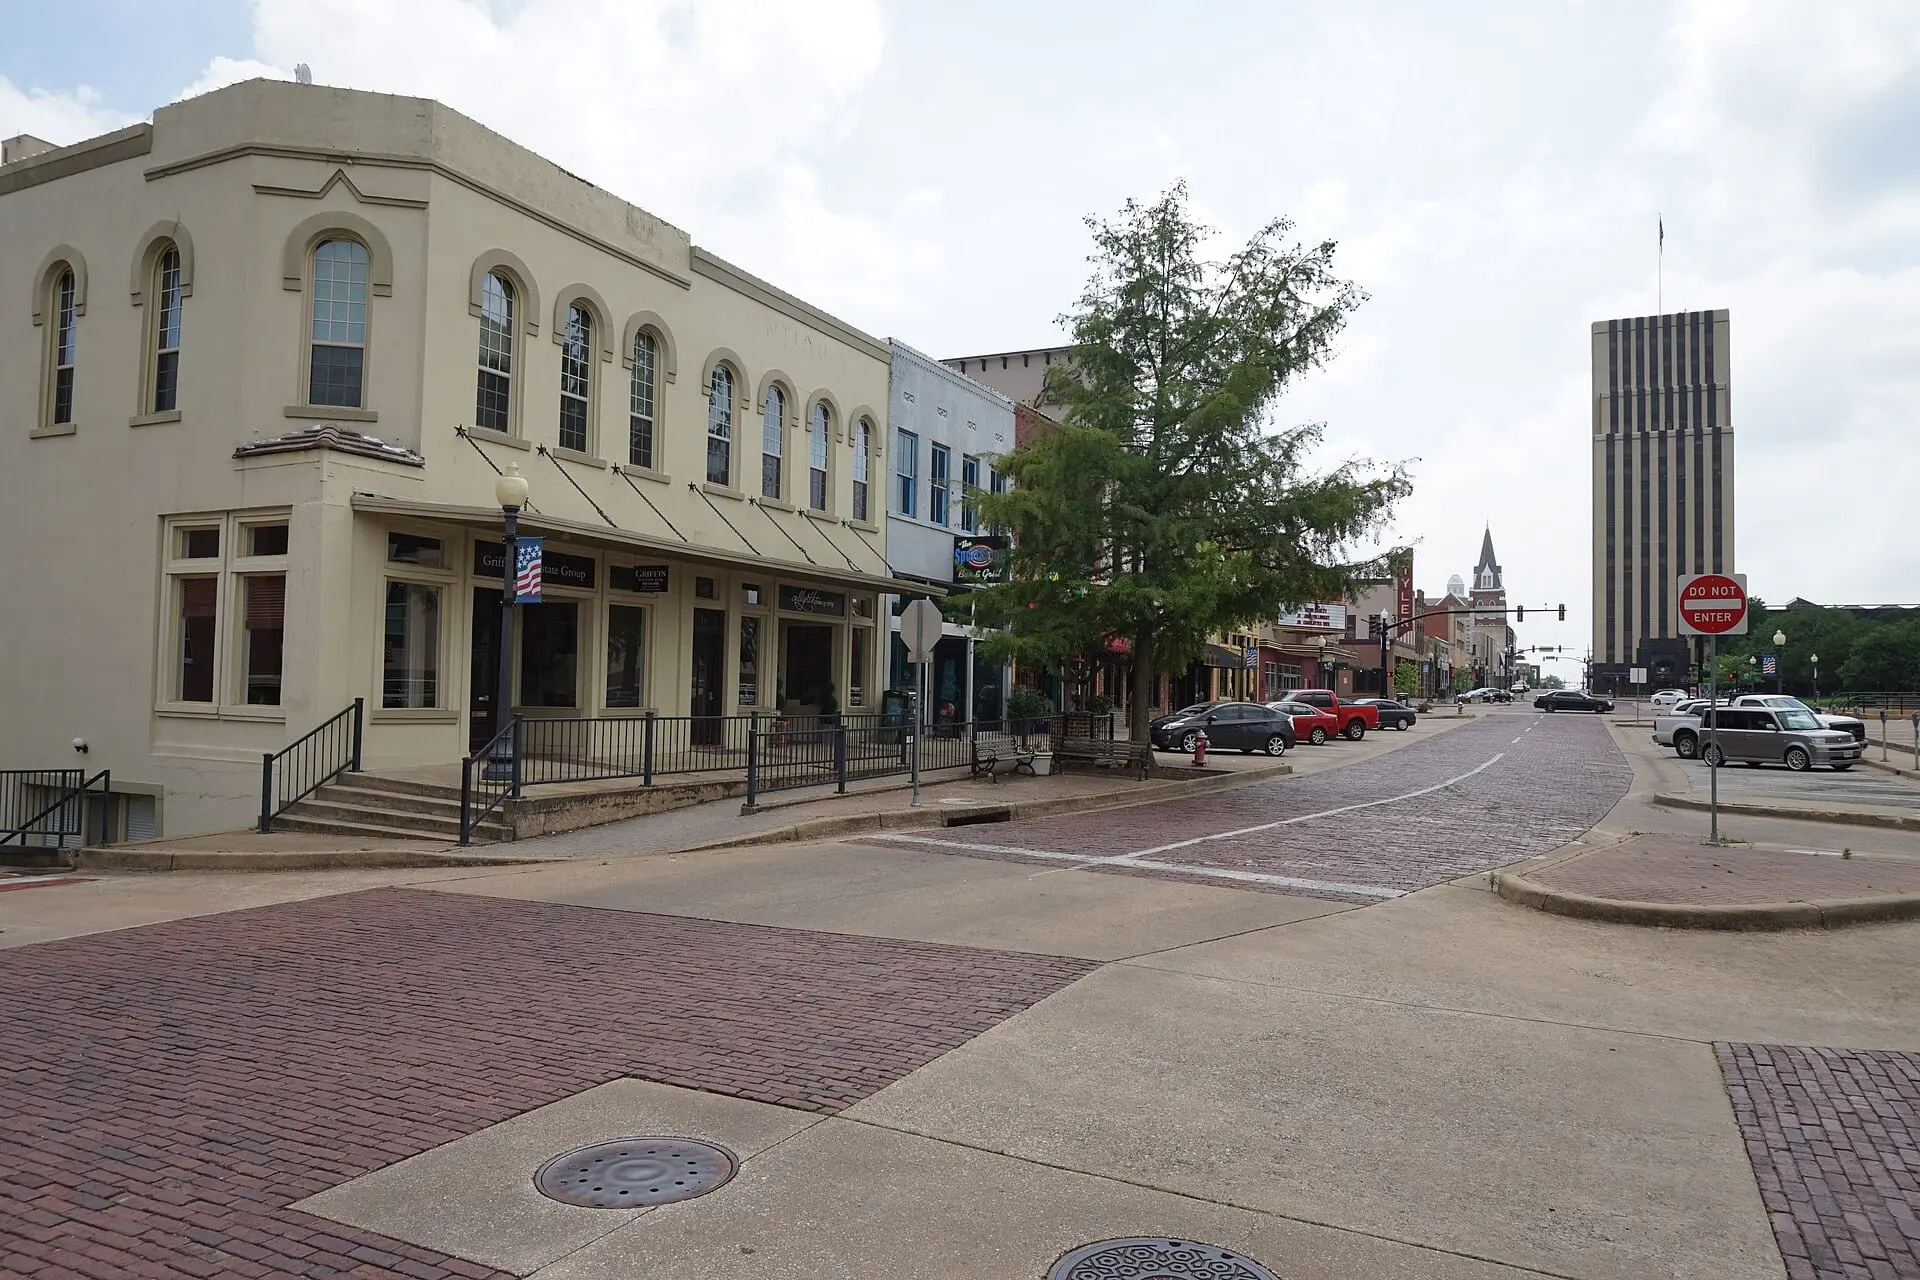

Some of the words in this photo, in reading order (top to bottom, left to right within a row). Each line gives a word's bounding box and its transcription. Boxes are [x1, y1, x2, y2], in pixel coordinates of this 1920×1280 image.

[560, 566, 586, 581] Group
[1690, 586, 1706, 596] DO
[1711, 586, 1736, 596] NOT
[1694, 612, 1732, 622] ENTER
